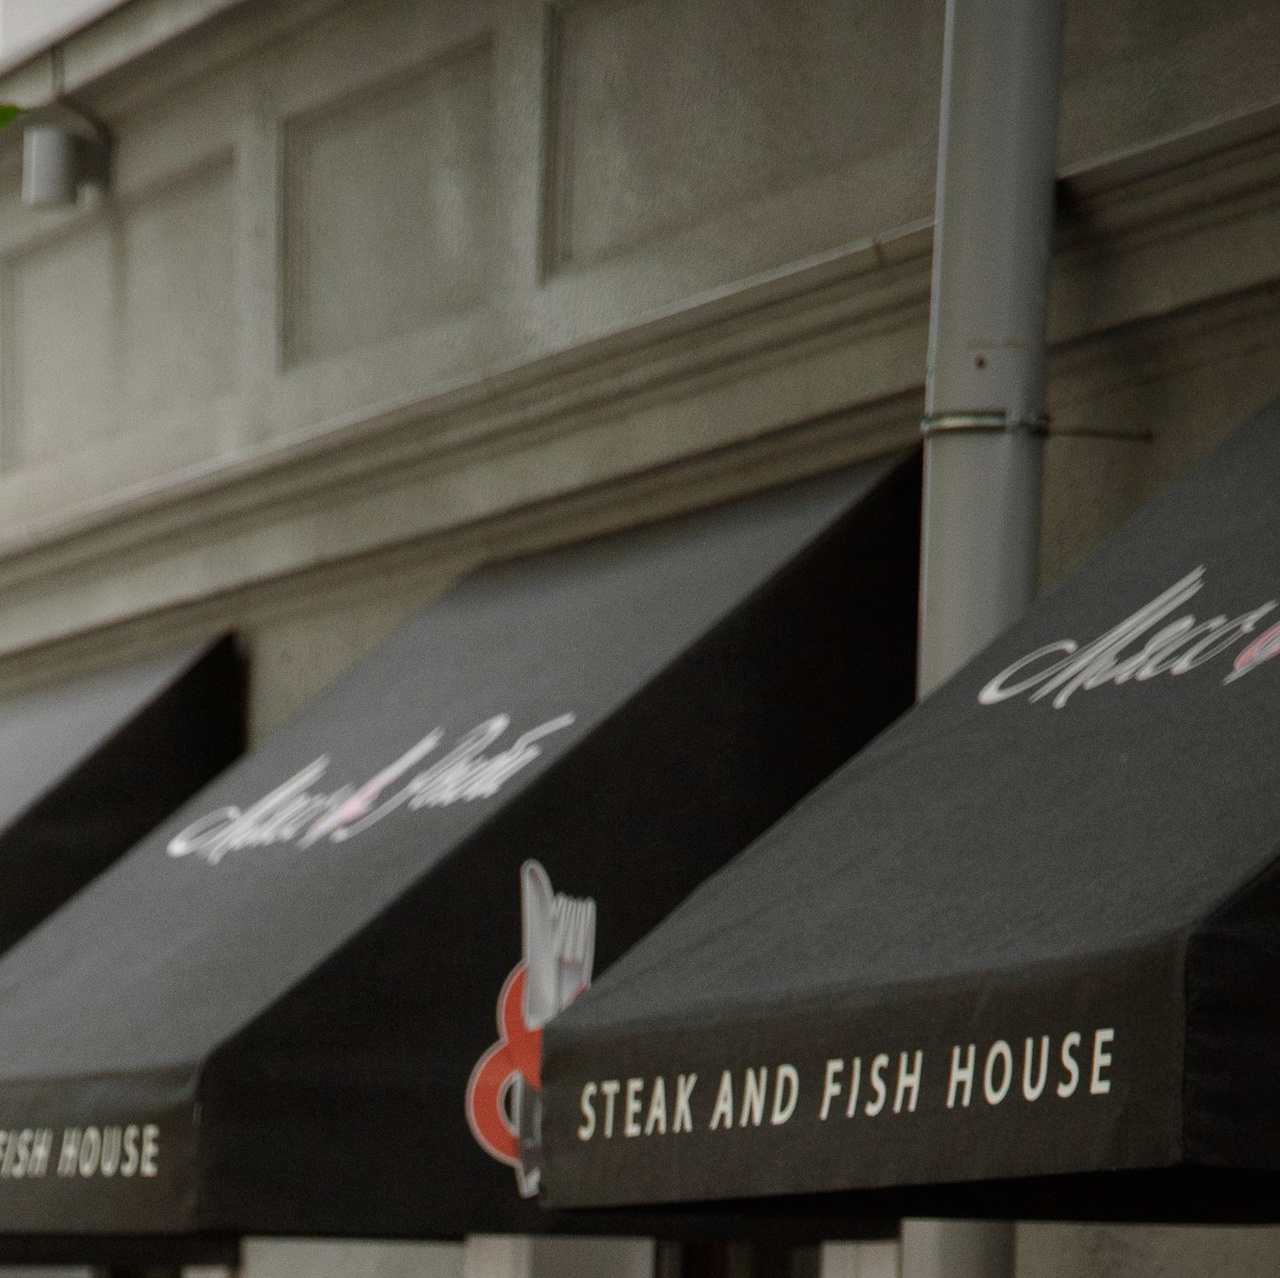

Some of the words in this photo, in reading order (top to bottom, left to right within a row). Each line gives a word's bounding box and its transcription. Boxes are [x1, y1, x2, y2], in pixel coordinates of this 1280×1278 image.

[578, 1072, 698, 1141] STEAK
[709, 1064, 799, 1131] AND
[819, 1050, 923, 1120] FISH
[946, 1028, 1115, 1109] HOUSE
[57, 1124, 160, 1178] HOUSE
